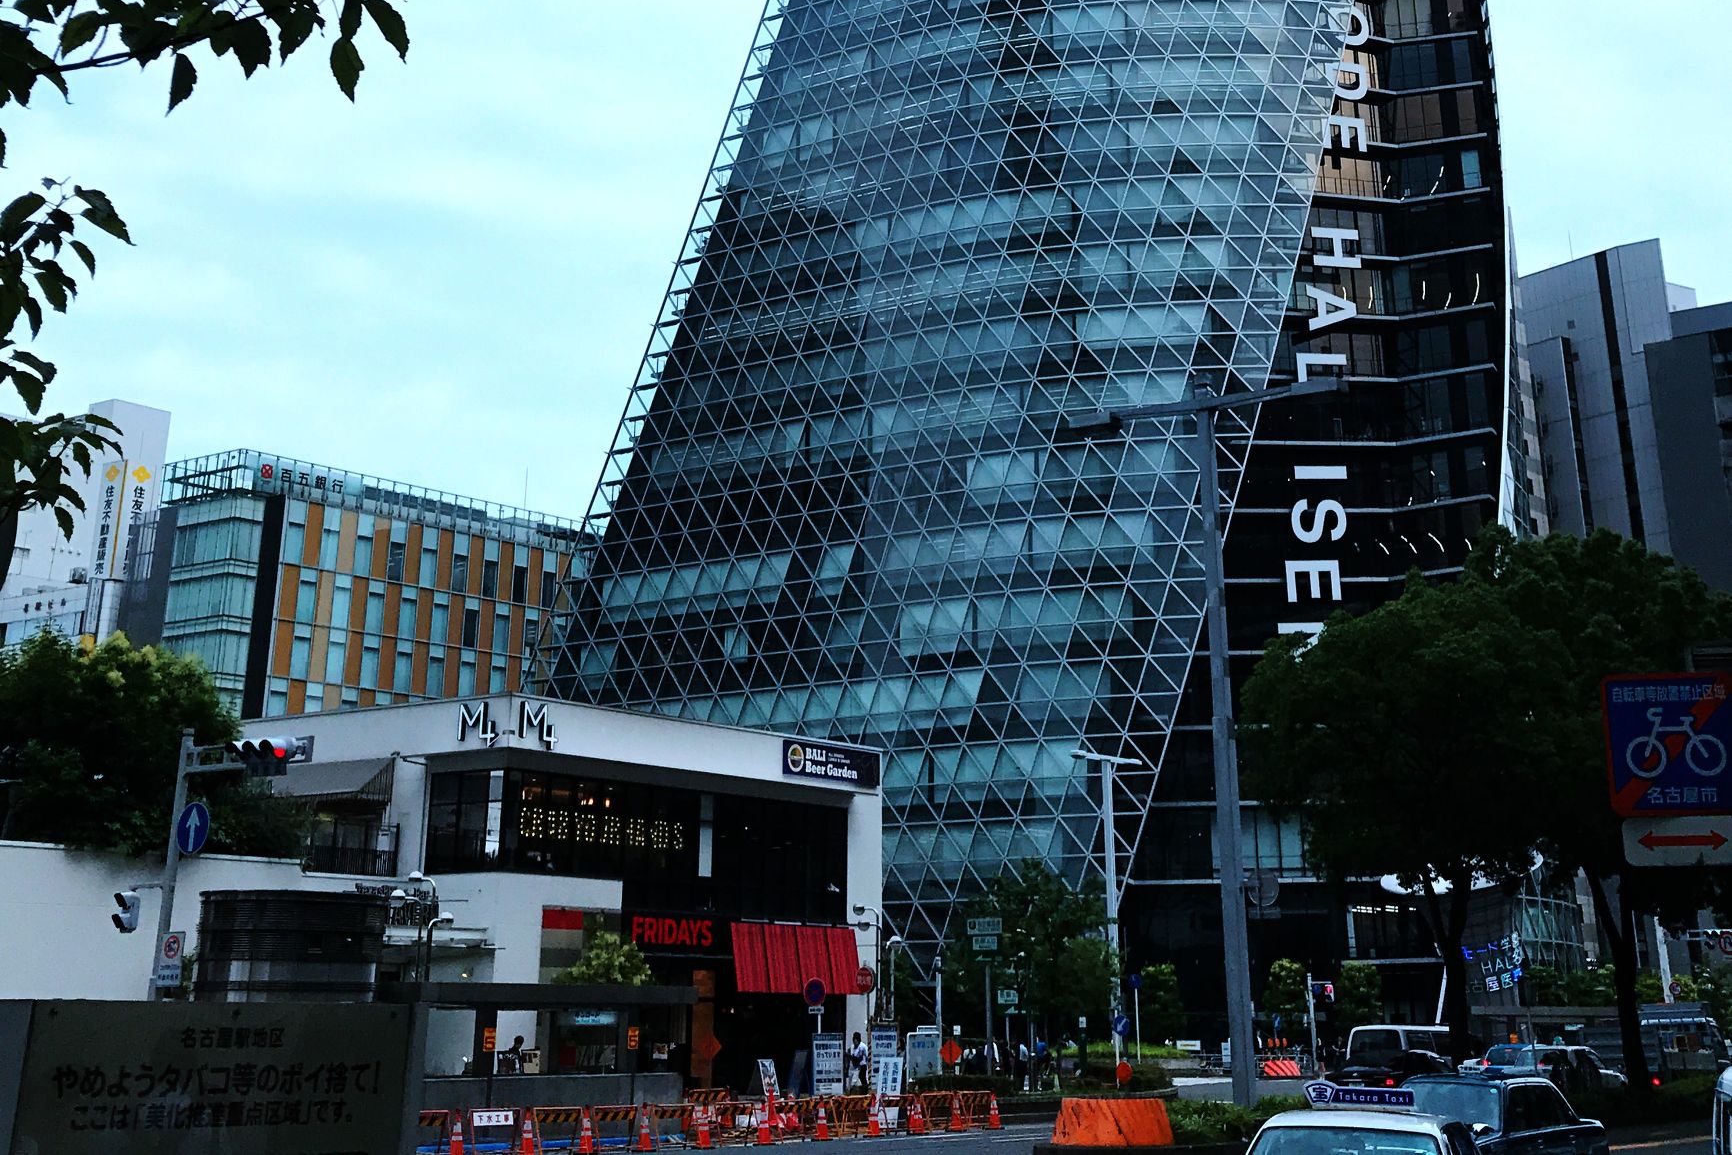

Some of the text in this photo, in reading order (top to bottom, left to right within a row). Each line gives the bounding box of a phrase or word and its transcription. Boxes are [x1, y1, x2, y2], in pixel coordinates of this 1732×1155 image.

[1296, 226, 1362, 383] HAL
[281, 468, 344, 494] 百五銀行
[94, 485, 115, 575] 住友不動産販売
[805, 747, 827, 762] BALI
[805, 760, 826, 775] Beer
[827, 763, 858, 780] Garden
[1647, 786, 1718, 804] 名古屋市
[631, 915, 714, 948] FRIDAYS
[181, 1027, 286, 1048] 名古屋駅地区
[1312, 1085, 1328, 1100] 宝
[1339, 1091, 1409, 1103] Takara Taxi
